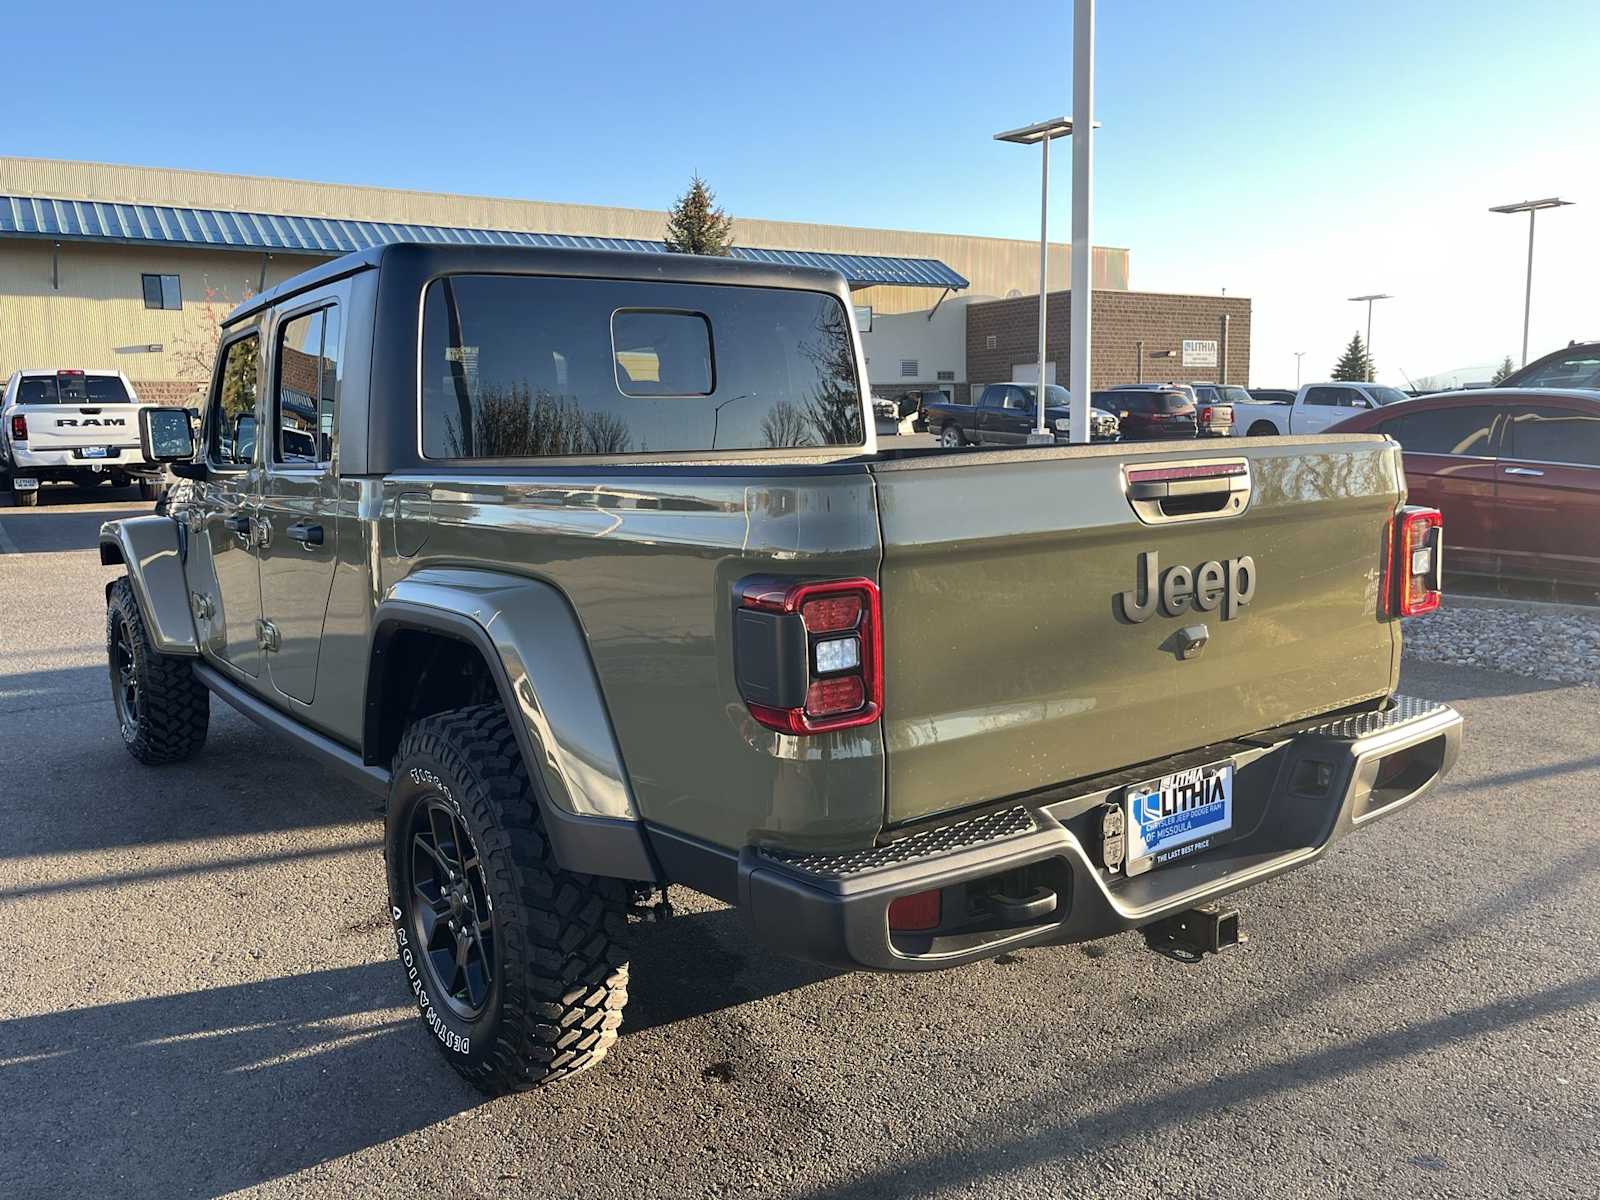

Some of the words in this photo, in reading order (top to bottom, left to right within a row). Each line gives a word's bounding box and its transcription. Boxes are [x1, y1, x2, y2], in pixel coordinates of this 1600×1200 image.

[1191, 342, 1216, 352] LITHIA
[56, 418, 126, 427] RAM
[1114, 551, 1256, 625] Jeep
[1162, 776, 1225, 817] LITHIA
[1176, 813, 1191, 823] JEEP
[1190, 807, 1209, 818] DODGE
[1210, 803, 1222, 812] RAM
[1146, 832, 1157, 843] OF
[1157, 821, 1192, 840] MISSOULA
[1157, 854, 1168, 864] THE
[1168, 849, 1181, 860] LAST
[1181, 845, 1194, 855] BEST
[1195, 840, 1210, 851] PRICE
[397, 928, 470, 1055] DESTINATION
